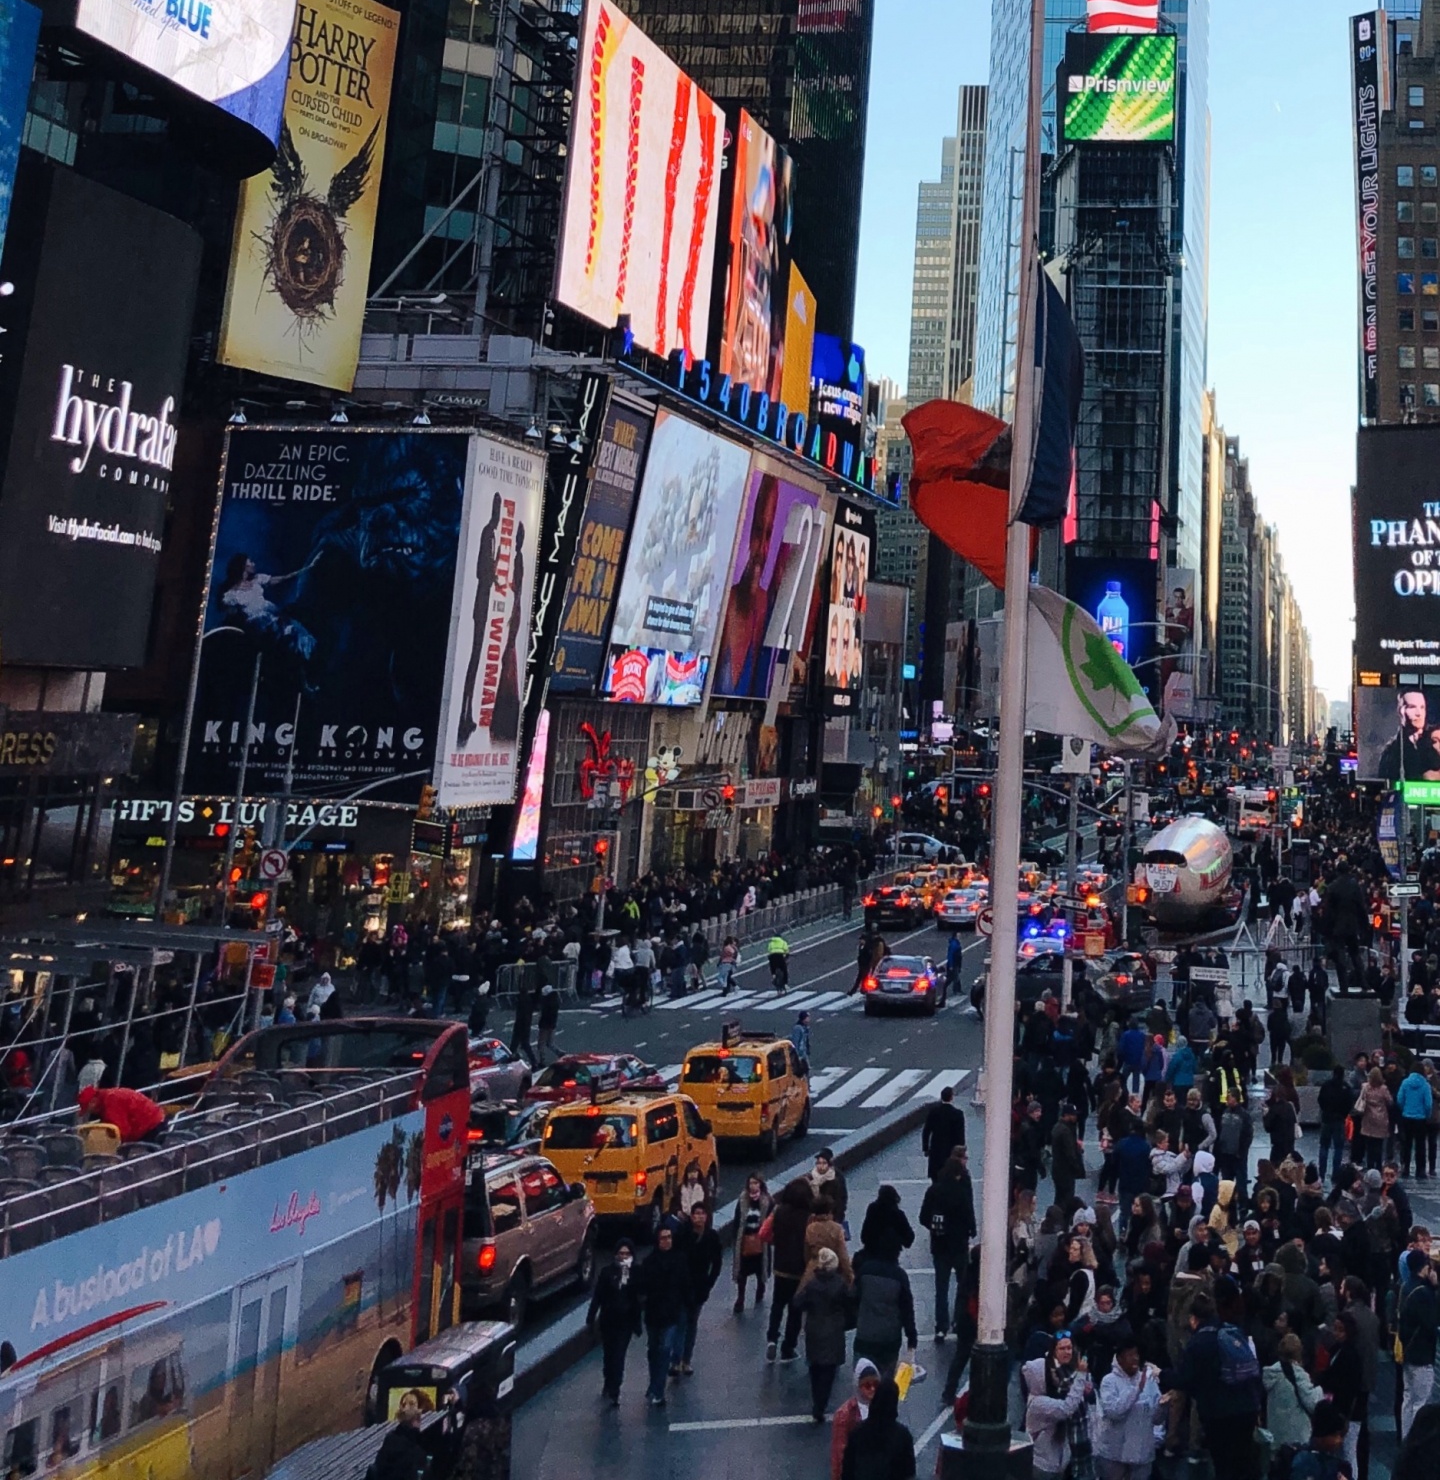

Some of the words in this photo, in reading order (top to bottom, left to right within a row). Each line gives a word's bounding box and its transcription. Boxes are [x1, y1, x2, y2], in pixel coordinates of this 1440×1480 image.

[352, 4, 364, 16] OF
[295, 3, 377, 71] HARRY
[287, 39, 374, 109] POTTER
[1085, 75, 1170, 92] Prismview
[291, 89, 330, 115] CURSED
[332, 106, 363, 128] CHILD
[315, 90, 329, 102] AND
[329, 92, 341, 106] THE
[299, 126, 310, 137] ON
[311, 129, 348, 152] BROADWAY
[1359, 84, 1378, 171] LIGHTS
[1362, 172, 1379, 249] YOUR
[77, 370, 116, 393] THE
[244, 463, 327, 481] DAZZLING
[479, 462, 498, 479] GOOD
[231, 483, 286, 500] THRILL
[49, 515, 66, 533] Visit
[67, 518, 135, 544] HydraFacial.com
[582, 520, 625, 564] COME
[494, 499, 516, 597] PRETTY
[1411, 550, 1433, 566] OF
[563, 595, 610, 636] AWAY
[1388, 639, 1414, 651] Majestic
[1415, 639, 1440, 650] Theatre
[479, 617, 504, 728] WOMAN
[0, 732, 56, 764] RESS
[204, 721, 294, 746] KING
[320, 724, 424, 750] KONG
[318, 749, 423, 760] BROADWAY
[30, 1287, 49, 1333] A
[54, 1246, 147, 1324] busload
[151, 1234, 174, 1282] of
[176, 1225, 204, 1272] LA
